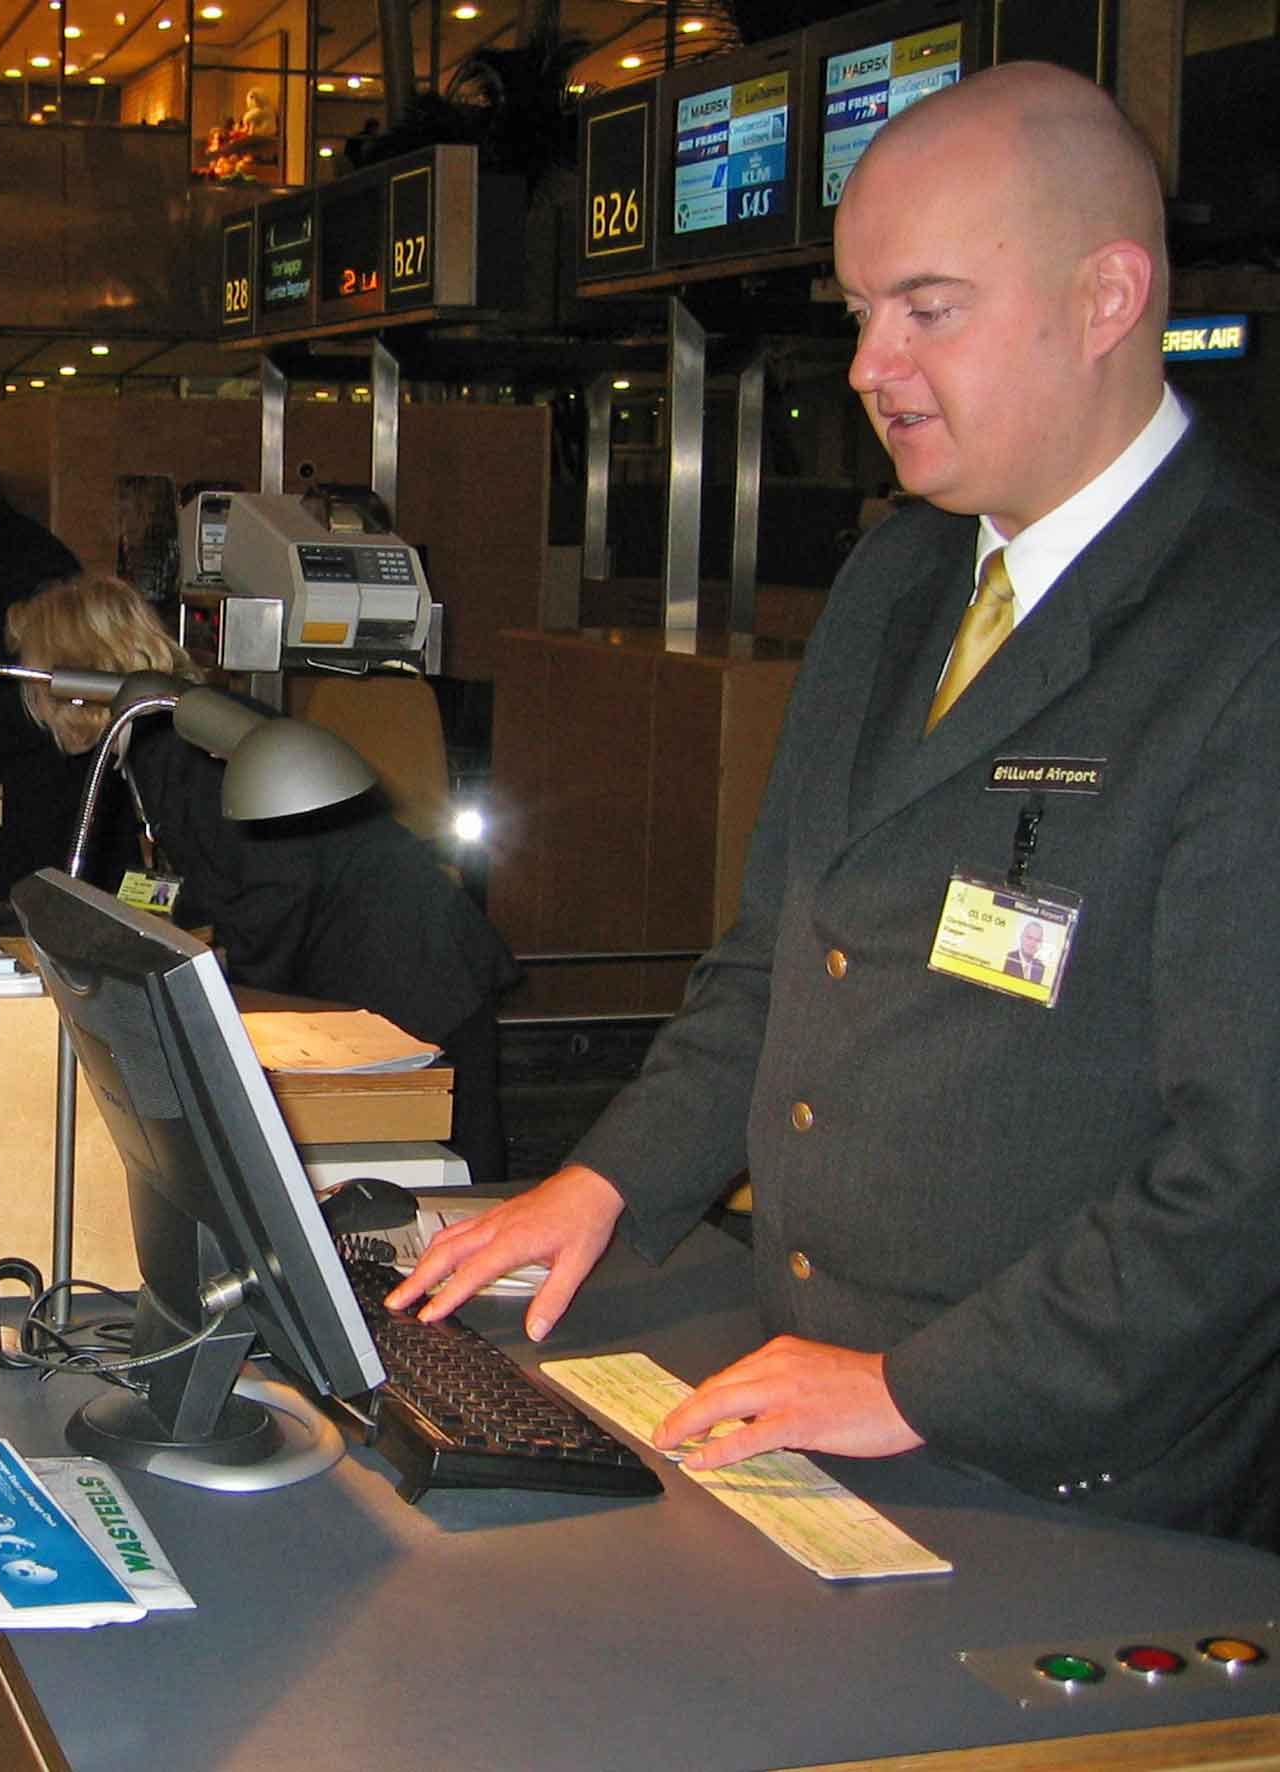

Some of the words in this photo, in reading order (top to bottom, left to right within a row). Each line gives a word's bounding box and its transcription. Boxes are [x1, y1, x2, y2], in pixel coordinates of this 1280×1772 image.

[842, 55, 888, 80] MAERSK
[690, 98, 730, 119] MAERSK
[827, 102, 846, 116] AIR
[848, 91, 888, 111] FRANCE
[678, 139, 694, 153] AIR
[695, 130, 729, 148] FRANCE
[741, 167, 771, 185] KLM
[593, 189, 639, 240] B26
[738, 188, 773, 220] SAS
[394, 235, 426, 278] B27
[225, 278, 249, 313] B28
[1208, 326, 1242, 350] AIR
[993, 766, 1044, 780] Billund
[1045, 767, 1097, 784] Airport
[77, 1476, 156, 1573] WASTEELS
